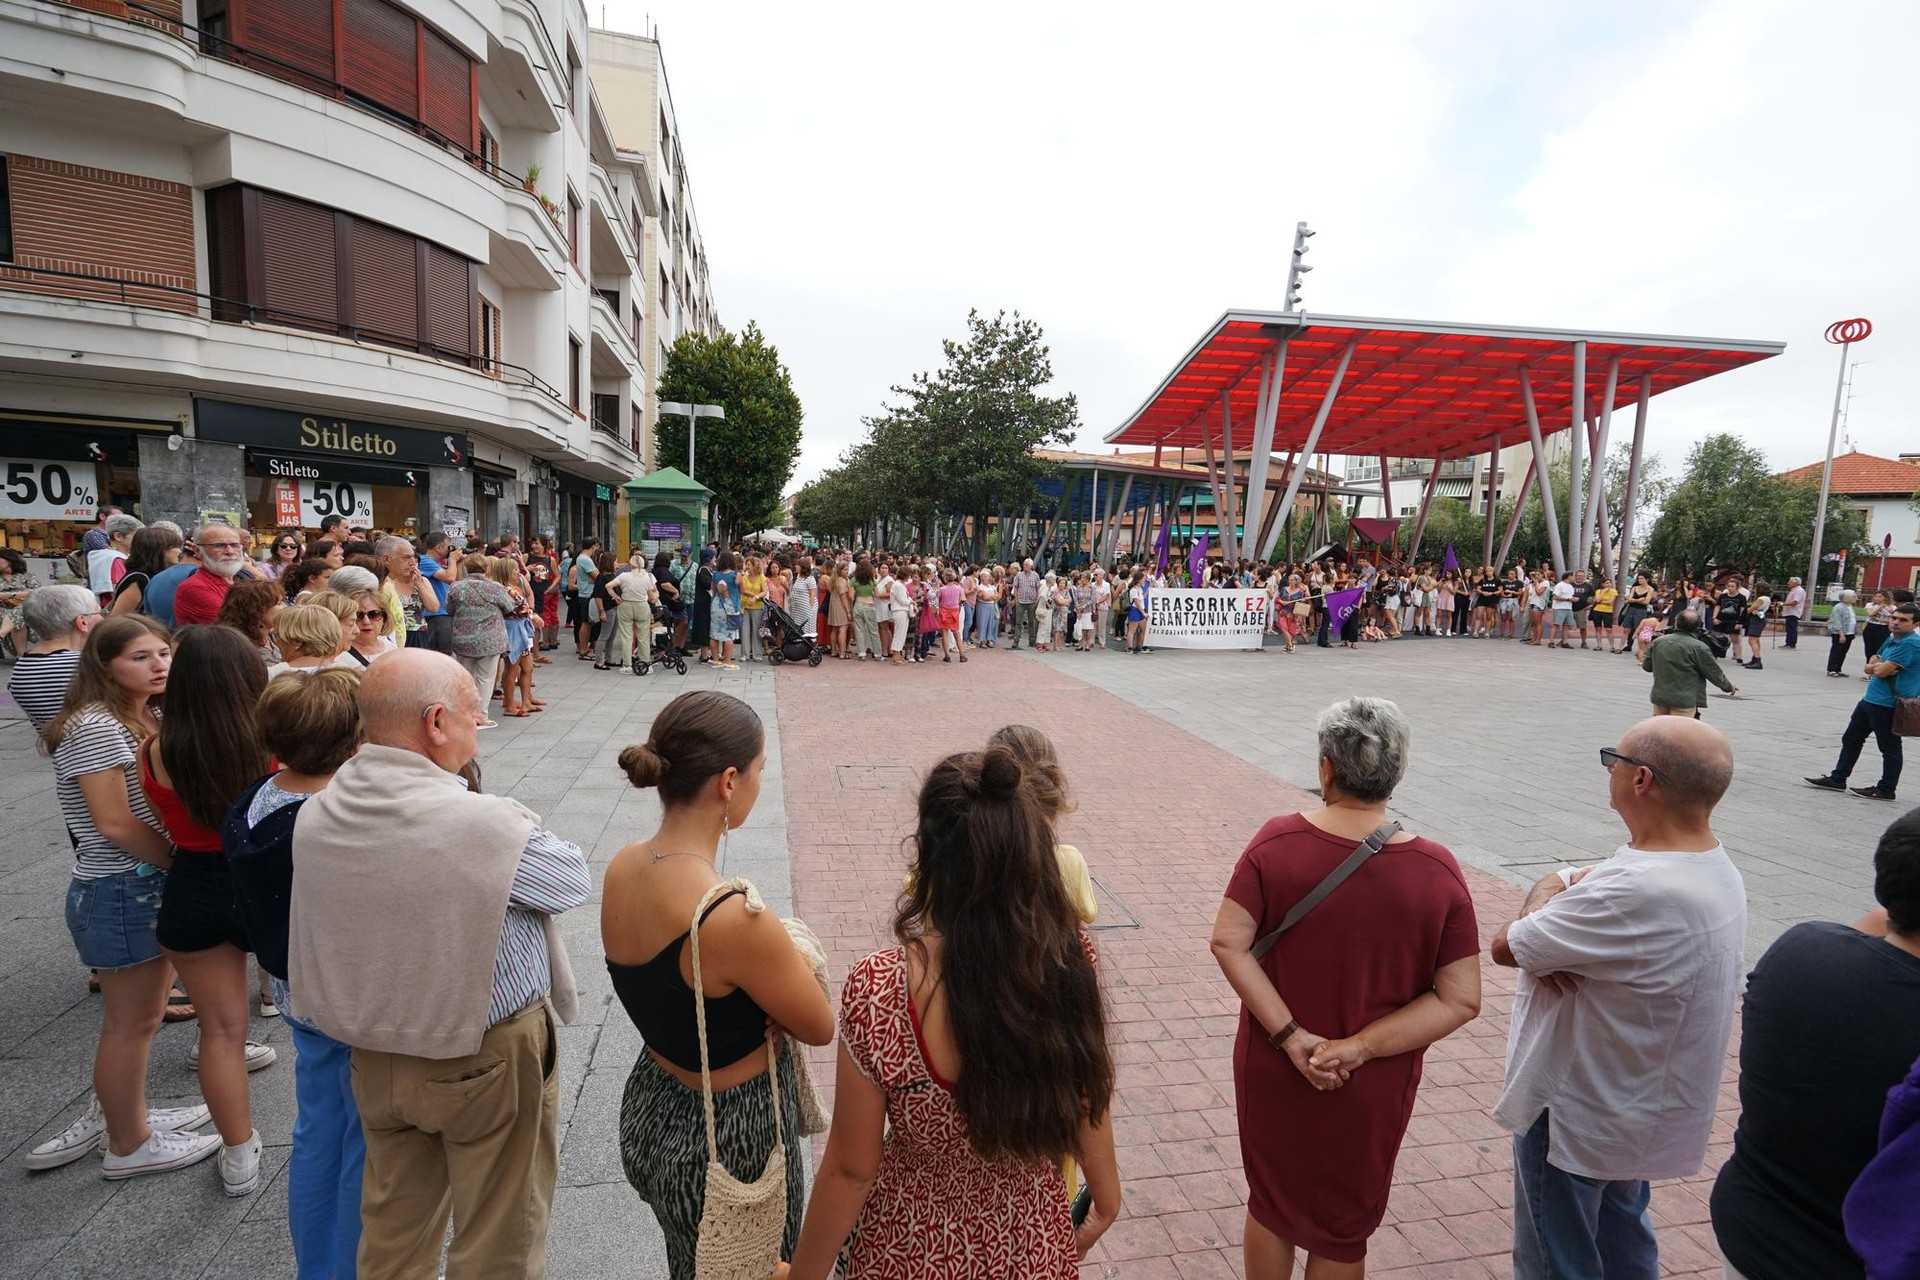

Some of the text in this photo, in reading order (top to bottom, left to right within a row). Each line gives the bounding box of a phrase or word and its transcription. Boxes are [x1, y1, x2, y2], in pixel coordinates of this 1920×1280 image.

[301, 417, 397, 456] Stiletto
[269, 459, 320, 479] Stiletto
[280, 491, 295, 501] RE
[64, 508, 92, 516] ARTE
[281, 503, 296, 514] BA
[279, 516, 300, 527] JAS
[1151, 597, 1265, 612] ERASORIK EZ
[1151, 612, 1265, 627] ERANTZUNIK GABE
